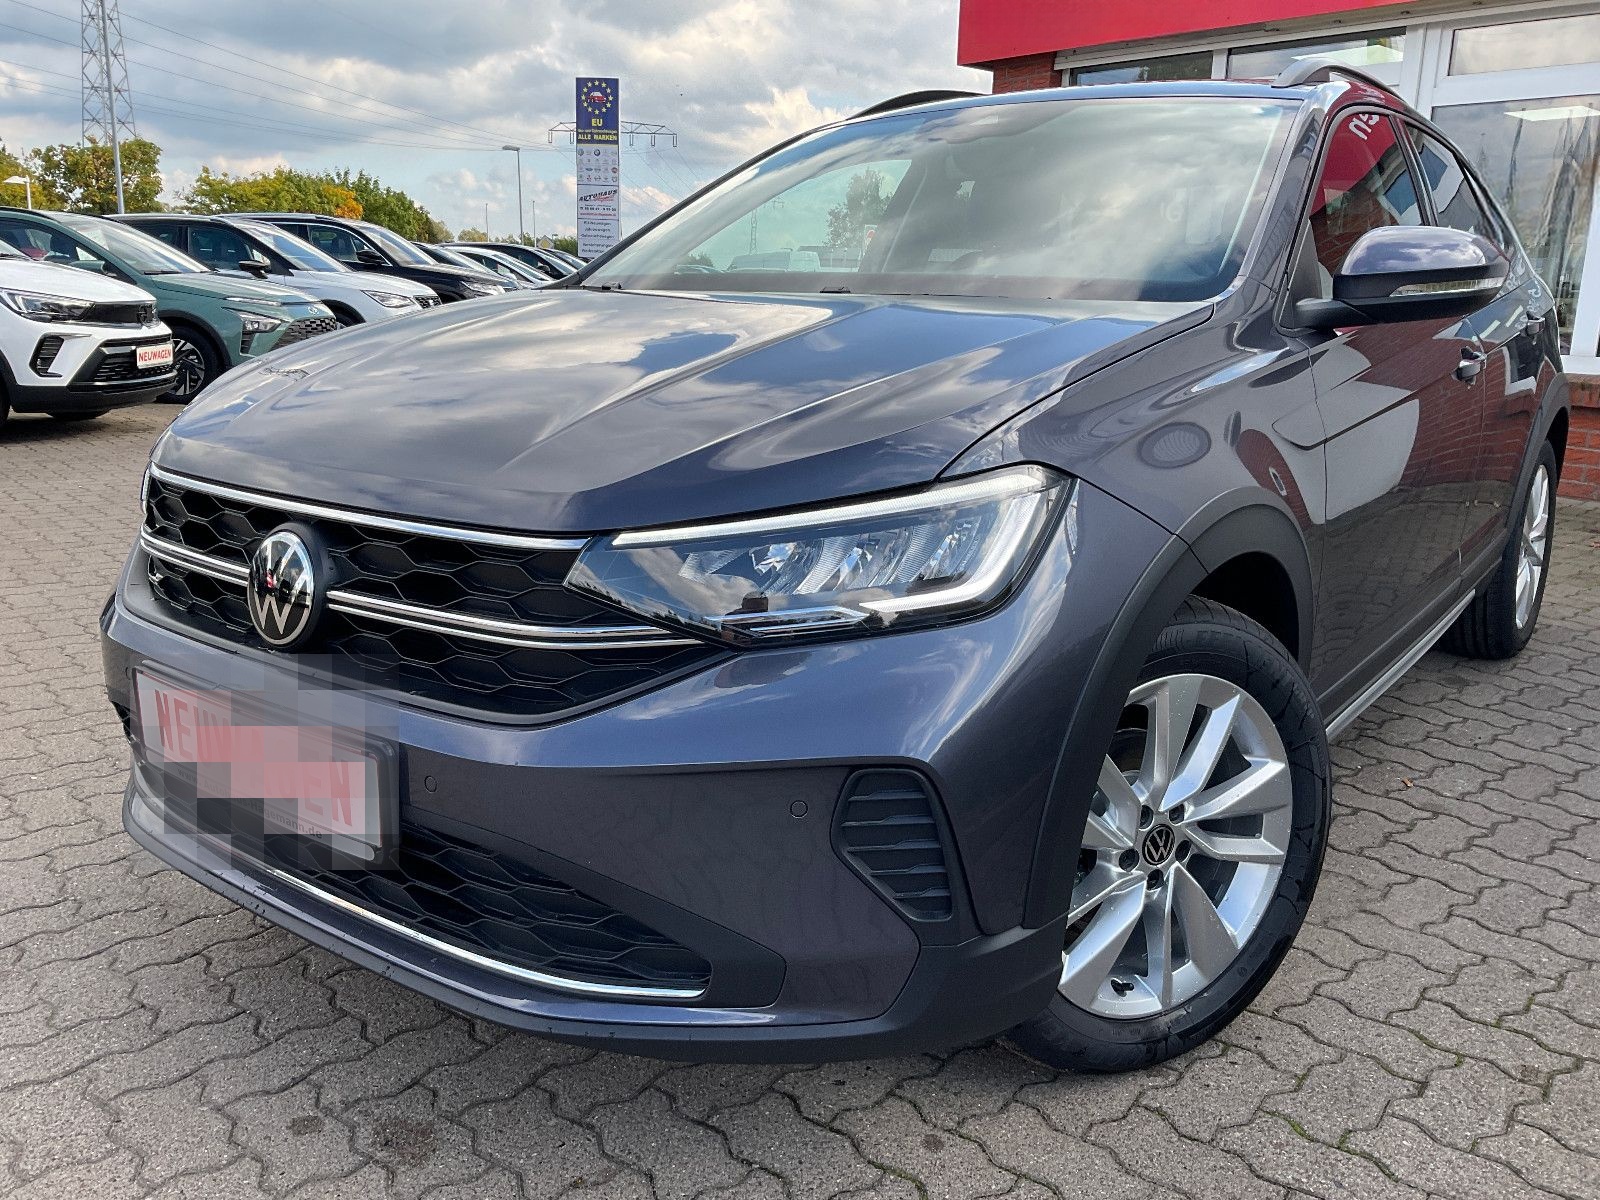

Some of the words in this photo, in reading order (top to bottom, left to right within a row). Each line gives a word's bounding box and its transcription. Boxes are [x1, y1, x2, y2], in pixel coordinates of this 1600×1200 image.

[591, 118, 603, 127] EU
[578, 189, 618, 202] AUTOHAUS
[138, 349, 172, 362] NEUWAGEN
